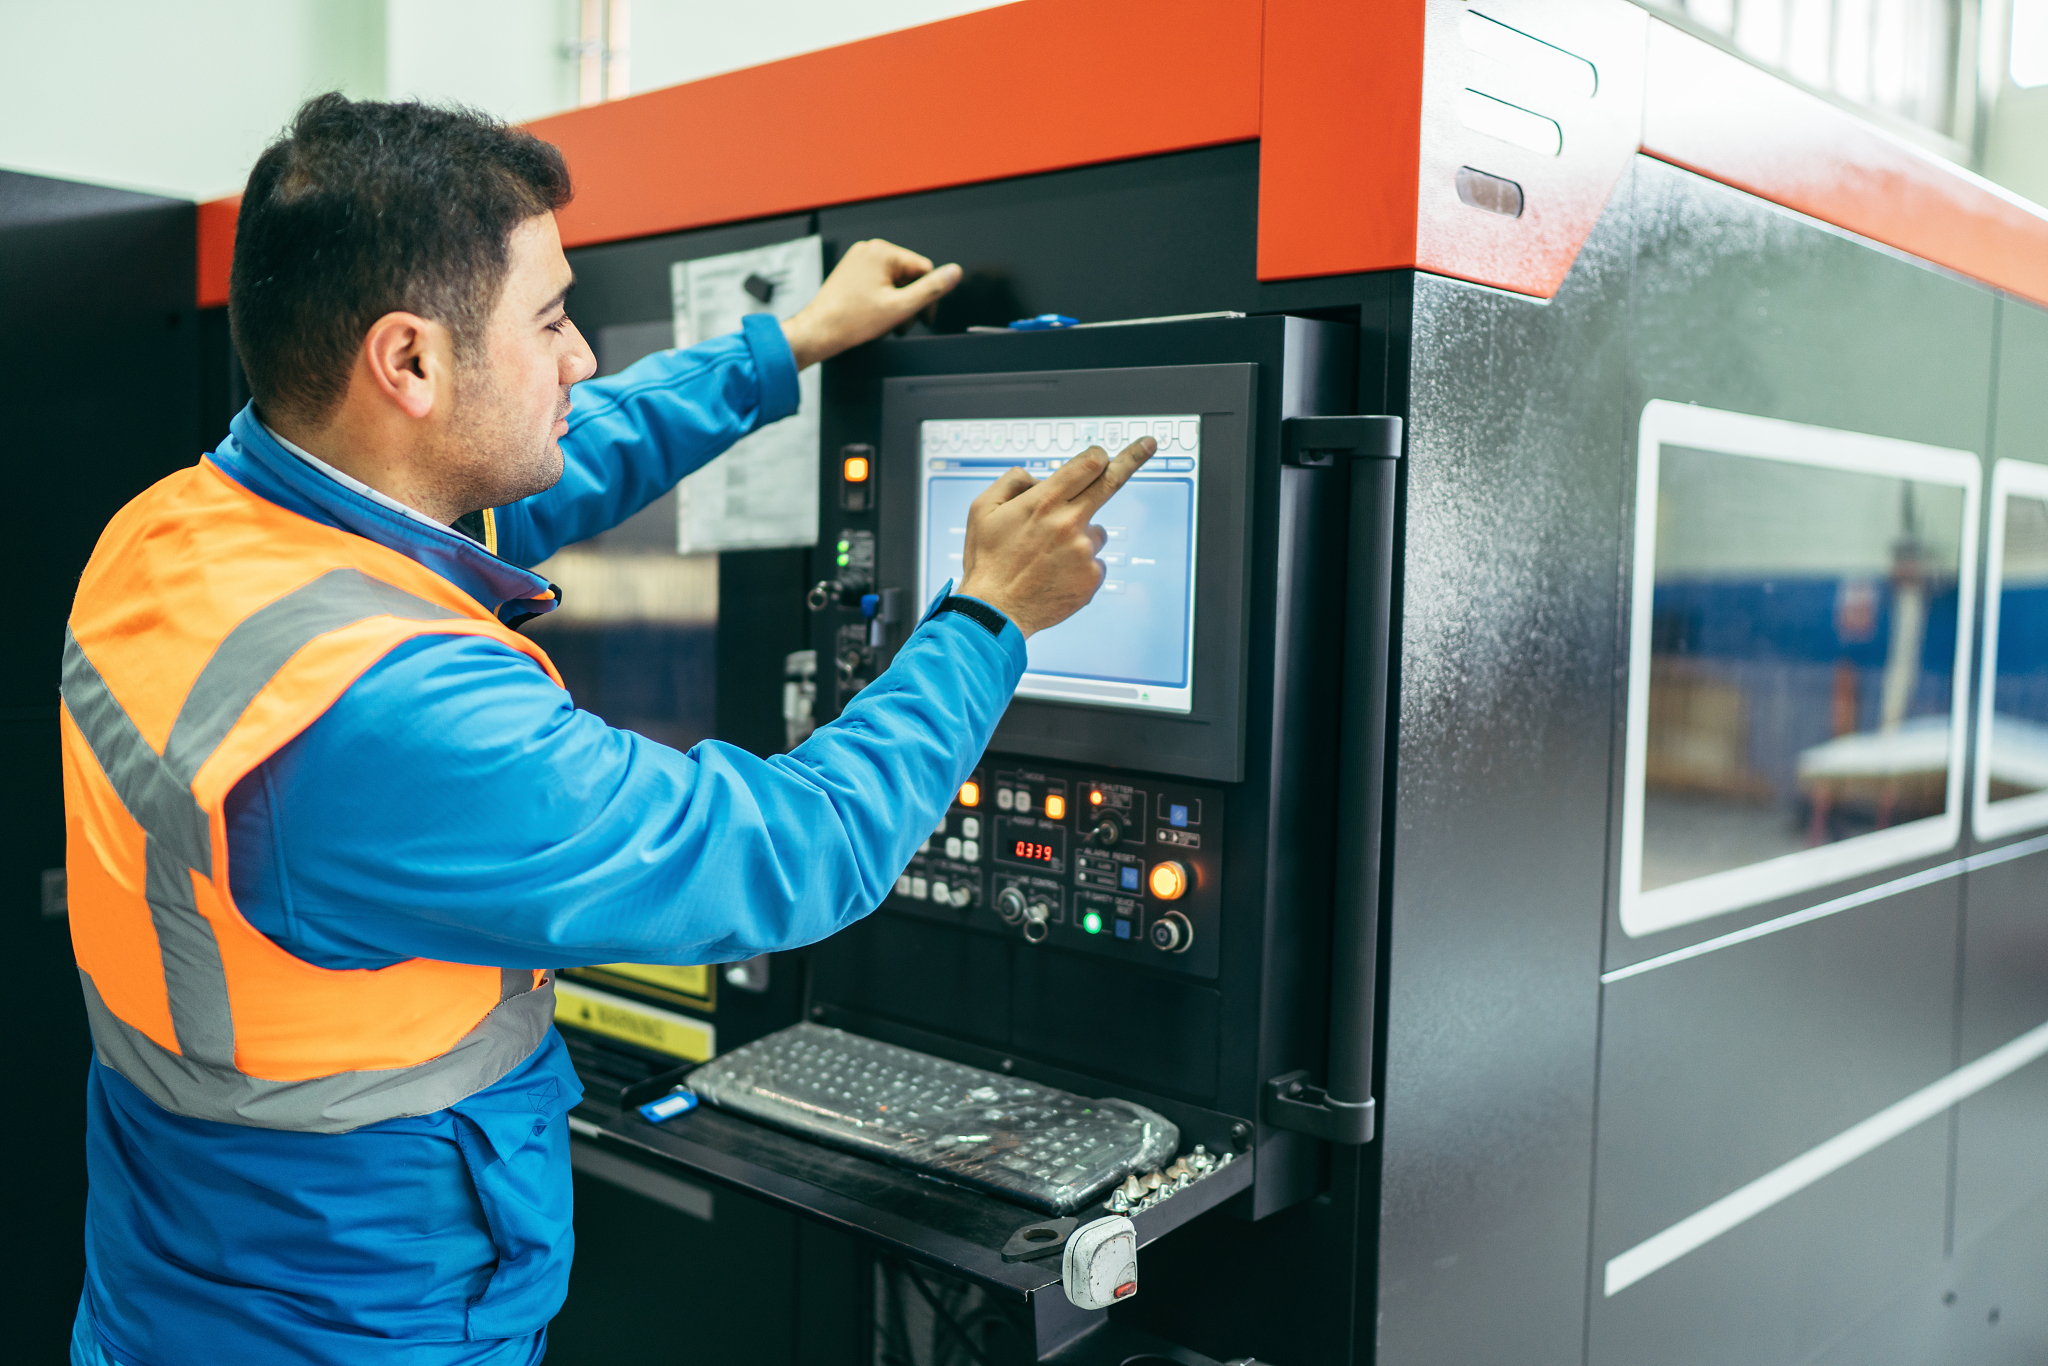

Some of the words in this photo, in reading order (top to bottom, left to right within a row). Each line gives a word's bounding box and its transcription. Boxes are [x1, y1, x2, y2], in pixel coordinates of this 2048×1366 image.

[1100, 782, 1133, 794] SHUTTER
[1084, 847, 1110, 859] ALARM
[1112, 852, 1136, 863] RESET
